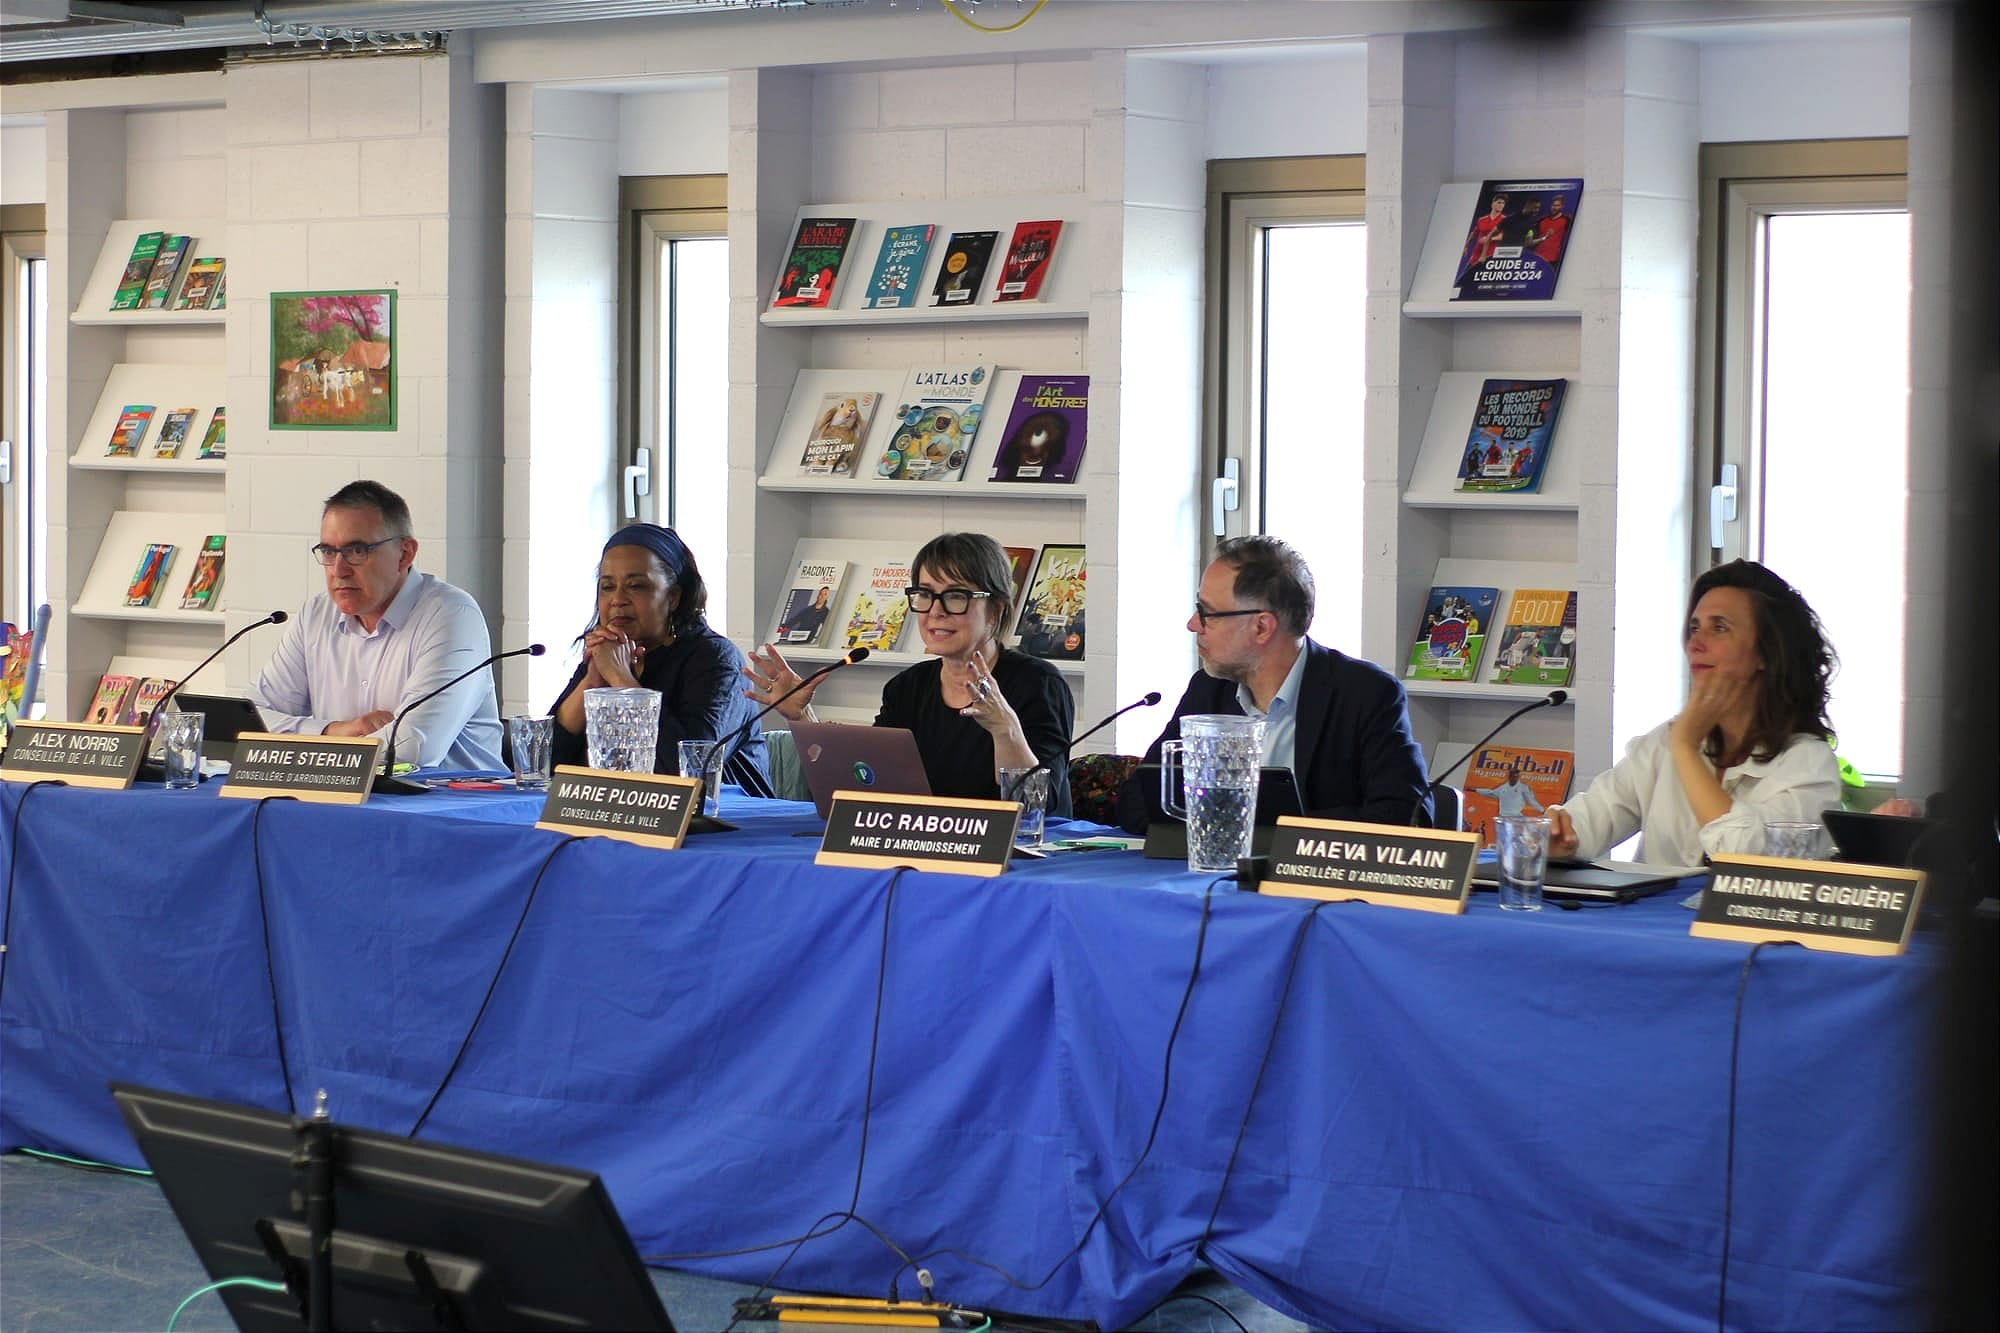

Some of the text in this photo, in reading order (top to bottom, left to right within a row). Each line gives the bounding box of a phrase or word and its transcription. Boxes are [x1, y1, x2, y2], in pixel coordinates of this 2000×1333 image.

[1486, 260, 1536, 270] GUIDE DE
[1474, 270, 1543, 281] L'EURO 2024
[915, 373, 968, 385] L'ATLAS
[931, 387, 976, 397] MONDE
[1037, 386, 1064, 396] l'Art
[1484, 386, 1553, 405] LES RECORDS
[1032, 397, 1088, 409] MONSTRES
[1488, 402, 1540, 415] DU MONDE
[1479, 414, 1543, 426] DU FOOTBALL
[808, 443, 855, 455] MON LAPIN
[801, 566, 836, 577] RACONTE
[872, 568, 882, 577] TU
[1511, 600, 1562, 624] FOOT
[29, 732, 120, 752] ALEX NORRIS
[12, 748, 127, 768] CONSEILLER DE LA VILLE
[246, 749, 362, 769] MARIE STERLIN
[286, 772, 361, 786] D'ARRONDISSEMENT
[558, 783, 681, 811] MARIE PLOURDE
[560, 806, 660, 828] CONSEILLÈRE DE LA VILLE
[855, 811, 989, 836] LUC RABOUIN
[850, 836, 981, 856] MAIRE D'ARRONDISSEMENT
[1295, 838, 1447, 869] MAEVA VILAIN
[1275, 862, 1455, 891] CONSEILLÈRE D'ARRONDISSEMENT
[1712, 874, 1906, 911] MARIANNE GIGUÈRE
[1726, 904, 1875, 931] CONSEILLÈRE DE LA VILLE
